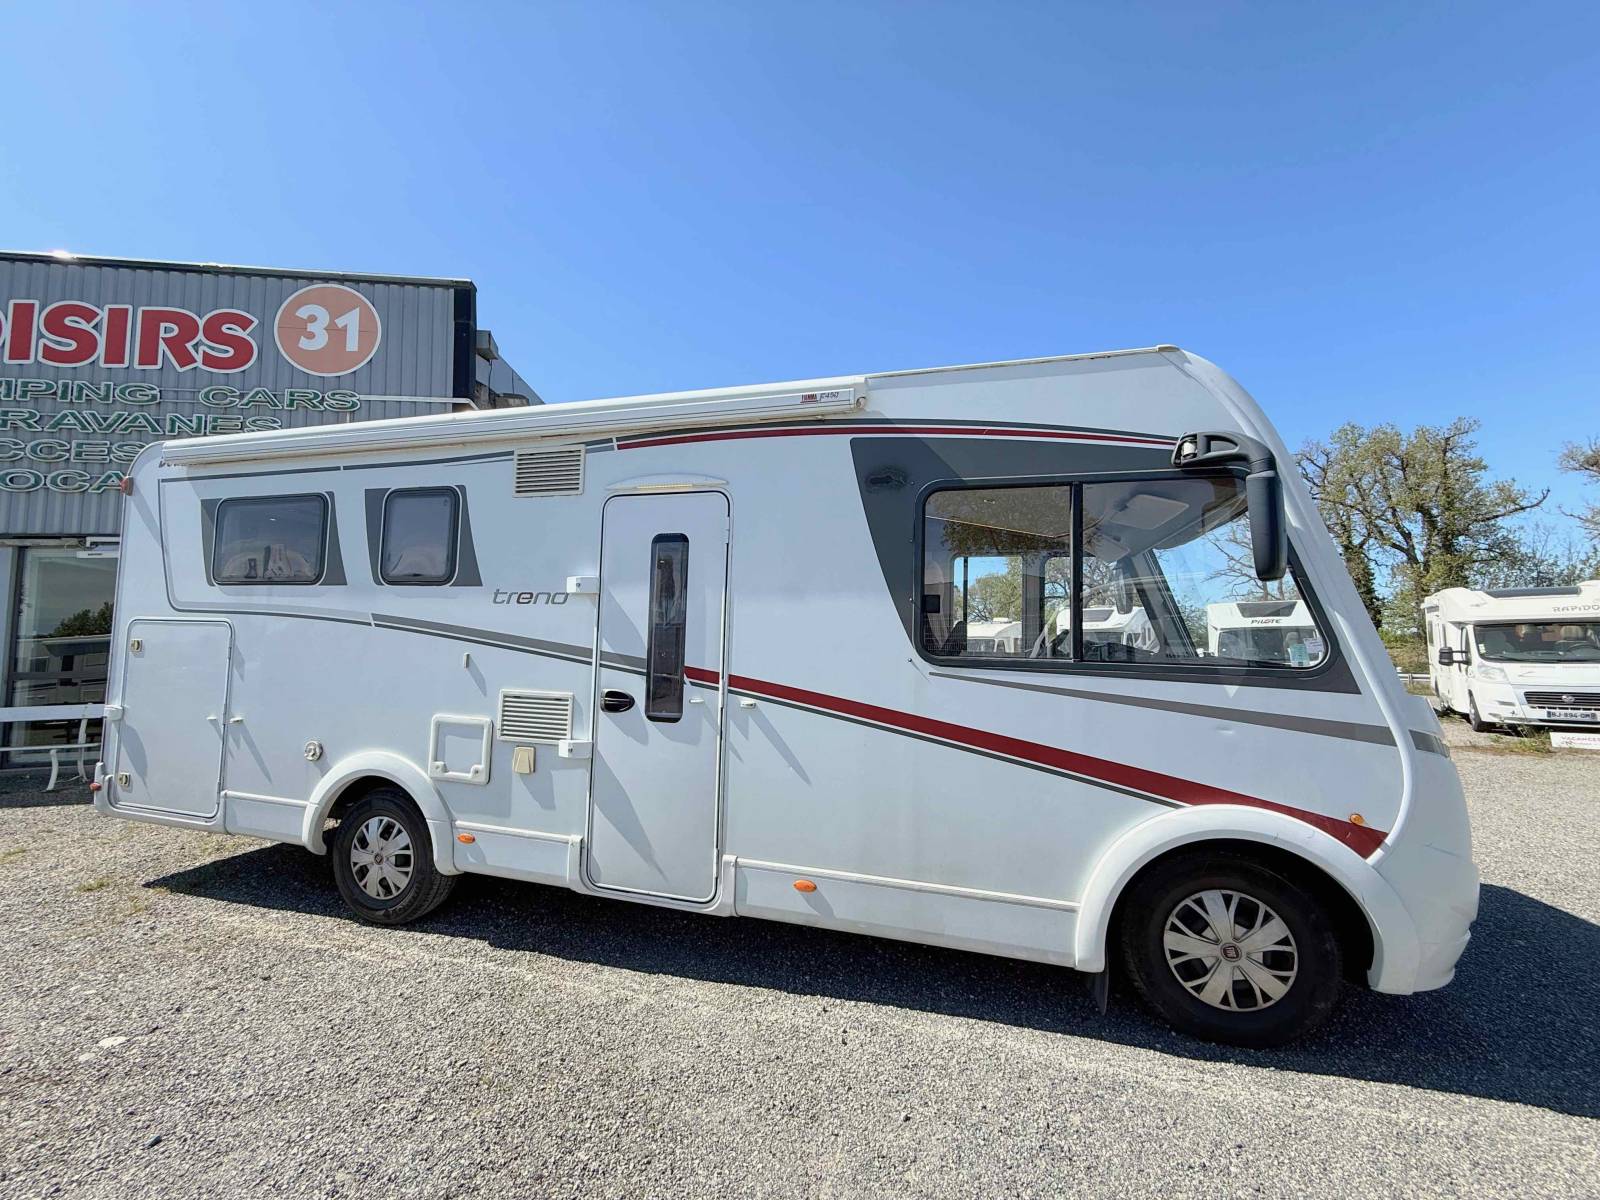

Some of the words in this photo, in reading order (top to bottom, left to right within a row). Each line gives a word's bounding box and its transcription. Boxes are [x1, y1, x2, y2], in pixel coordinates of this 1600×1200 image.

[0, 300, 259, 373] ISIRS
[295, 304, 361, 353] 31
[199, 385, 361, 412] CARS
[0, 407, 282, 435] RAVANES
